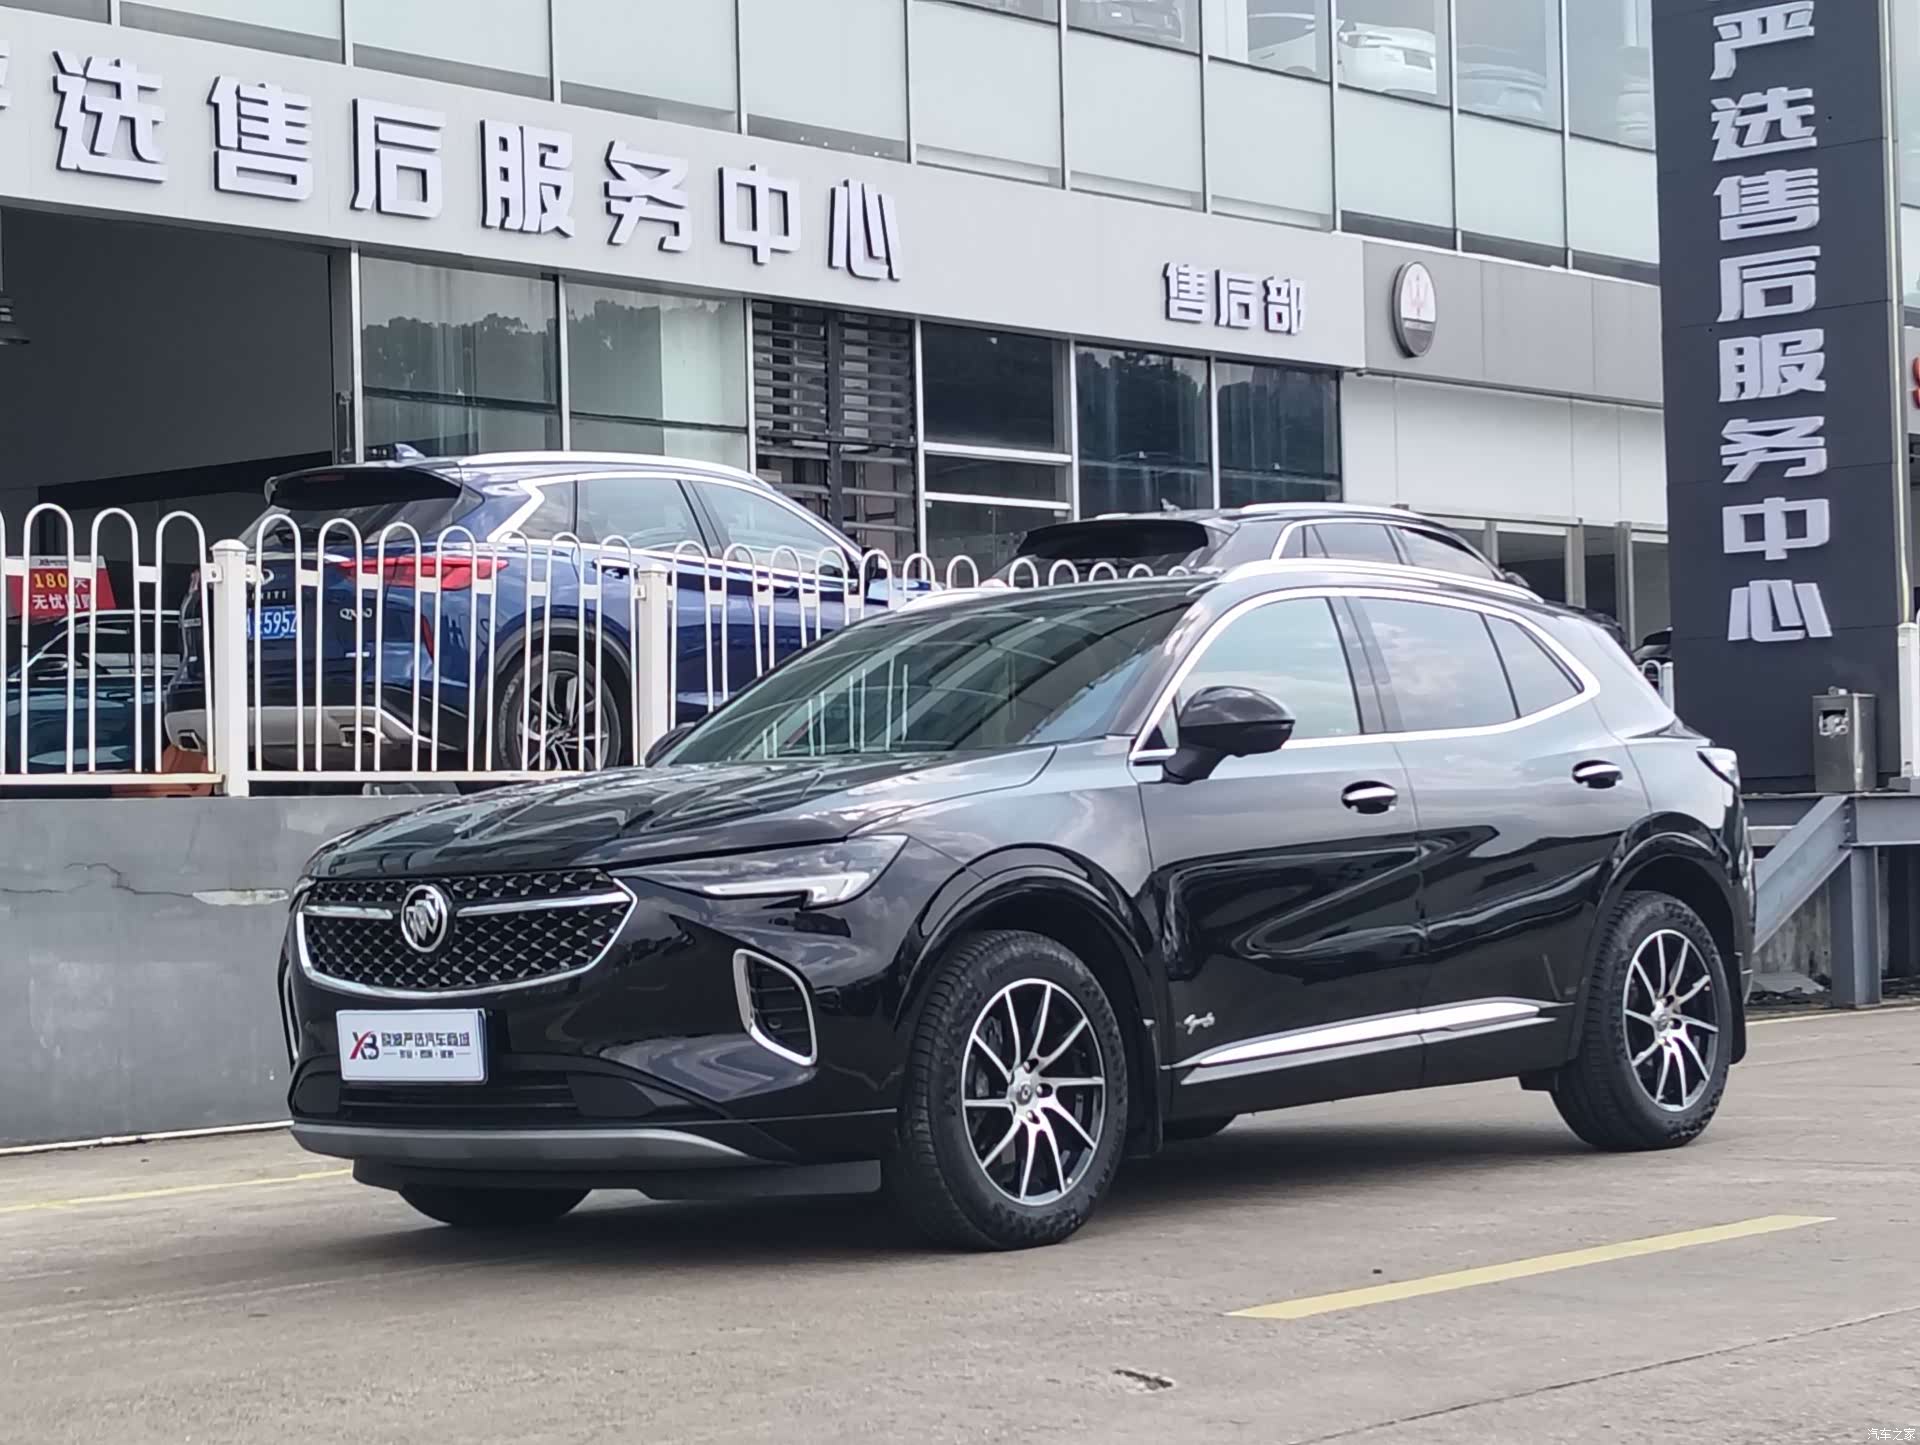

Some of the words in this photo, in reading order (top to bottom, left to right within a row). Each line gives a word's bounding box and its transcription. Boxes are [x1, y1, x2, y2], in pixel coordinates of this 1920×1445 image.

[0, 40, 902, 282] 选售后服务中心
[1161, 262, 1306, 336] 售后部
[1709, 0, 1833, 643] 严选售后服务中心
